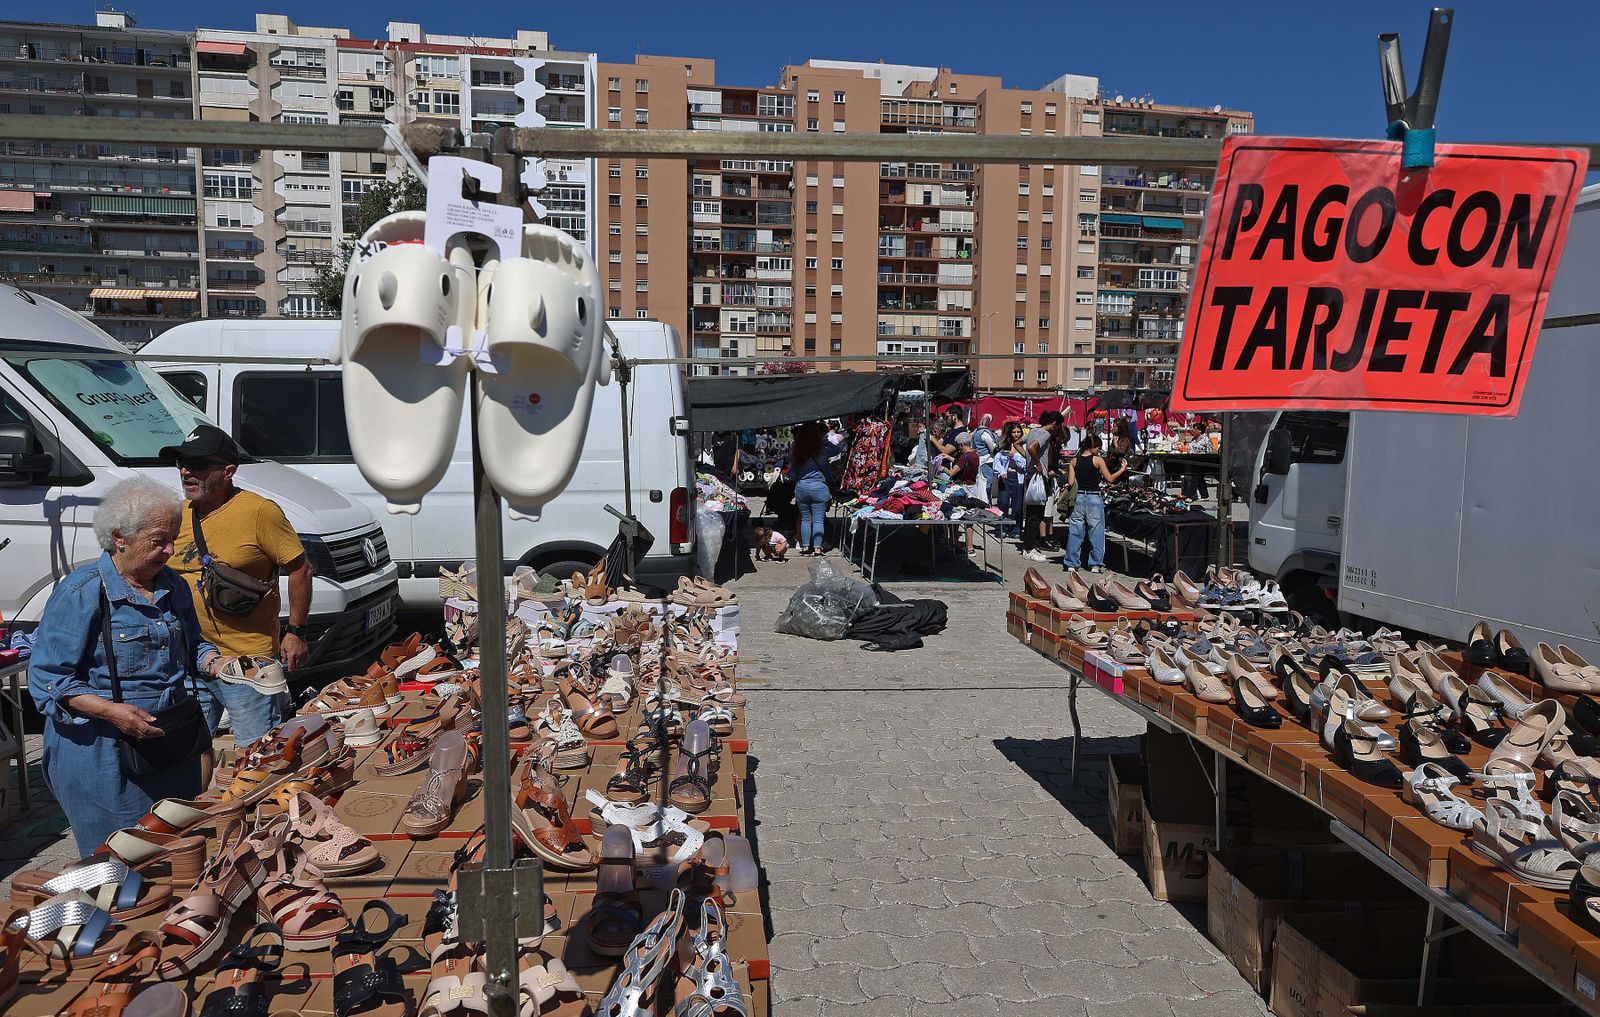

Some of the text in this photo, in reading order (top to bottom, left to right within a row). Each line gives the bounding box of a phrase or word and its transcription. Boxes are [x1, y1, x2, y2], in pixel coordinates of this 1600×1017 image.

[1220, 183, 1557, 270] PAGO CON
[1208, 286, 1511, 378] TARJETA
